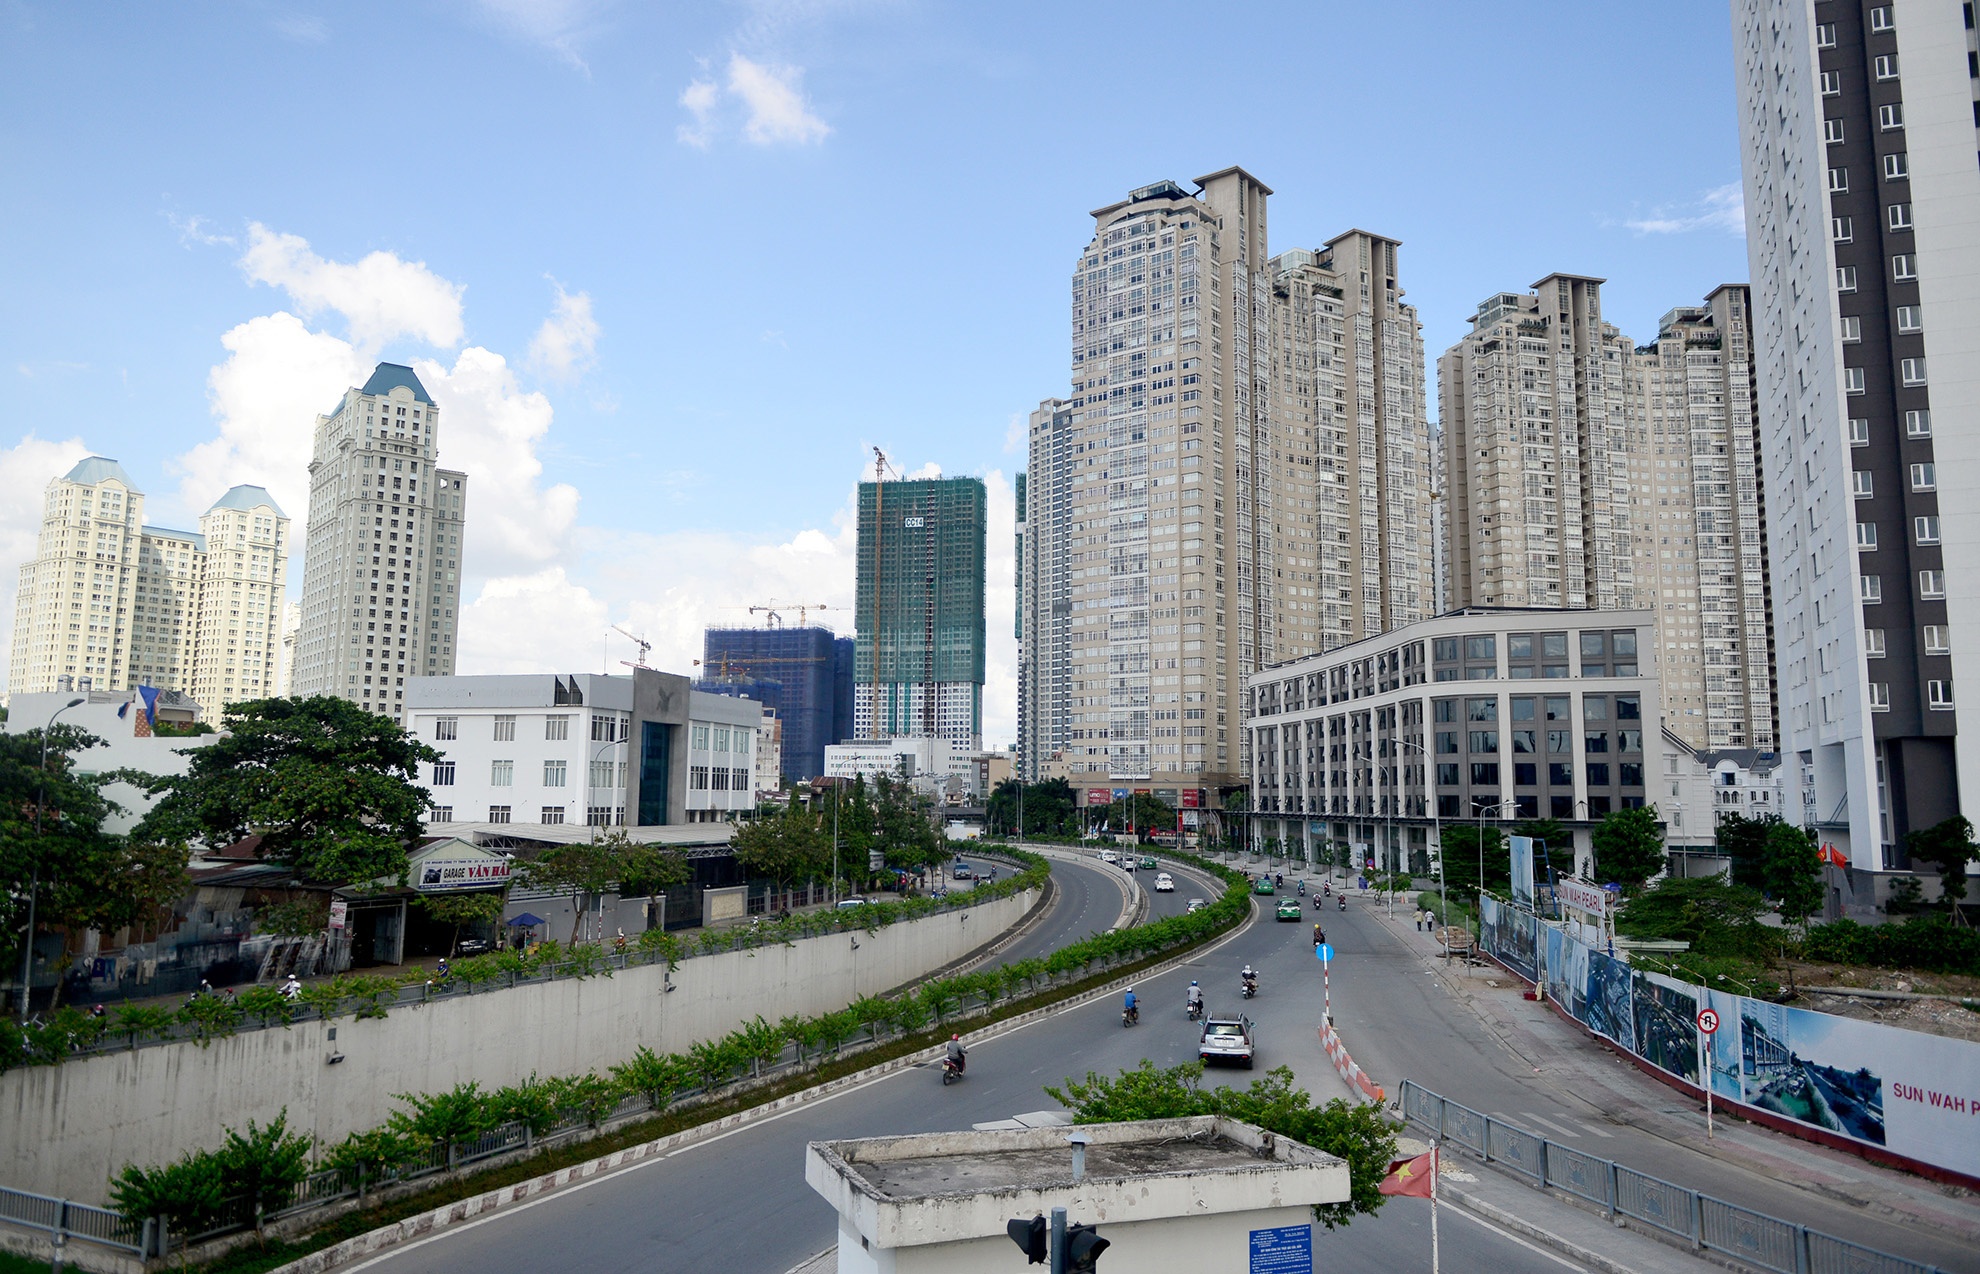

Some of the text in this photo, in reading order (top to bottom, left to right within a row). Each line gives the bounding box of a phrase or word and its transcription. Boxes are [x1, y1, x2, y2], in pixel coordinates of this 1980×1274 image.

[906, 518, 923, 527] CC14
[443, 868, 466, 879] GARAGE
[468, 864, 490, 877] VĂN
[1559, 883, 1602, 912] SUN WAH PEARL
[1893, 1082, 1924, 1103] SUN
[1928, 1090, 1965, 1113] WAH
